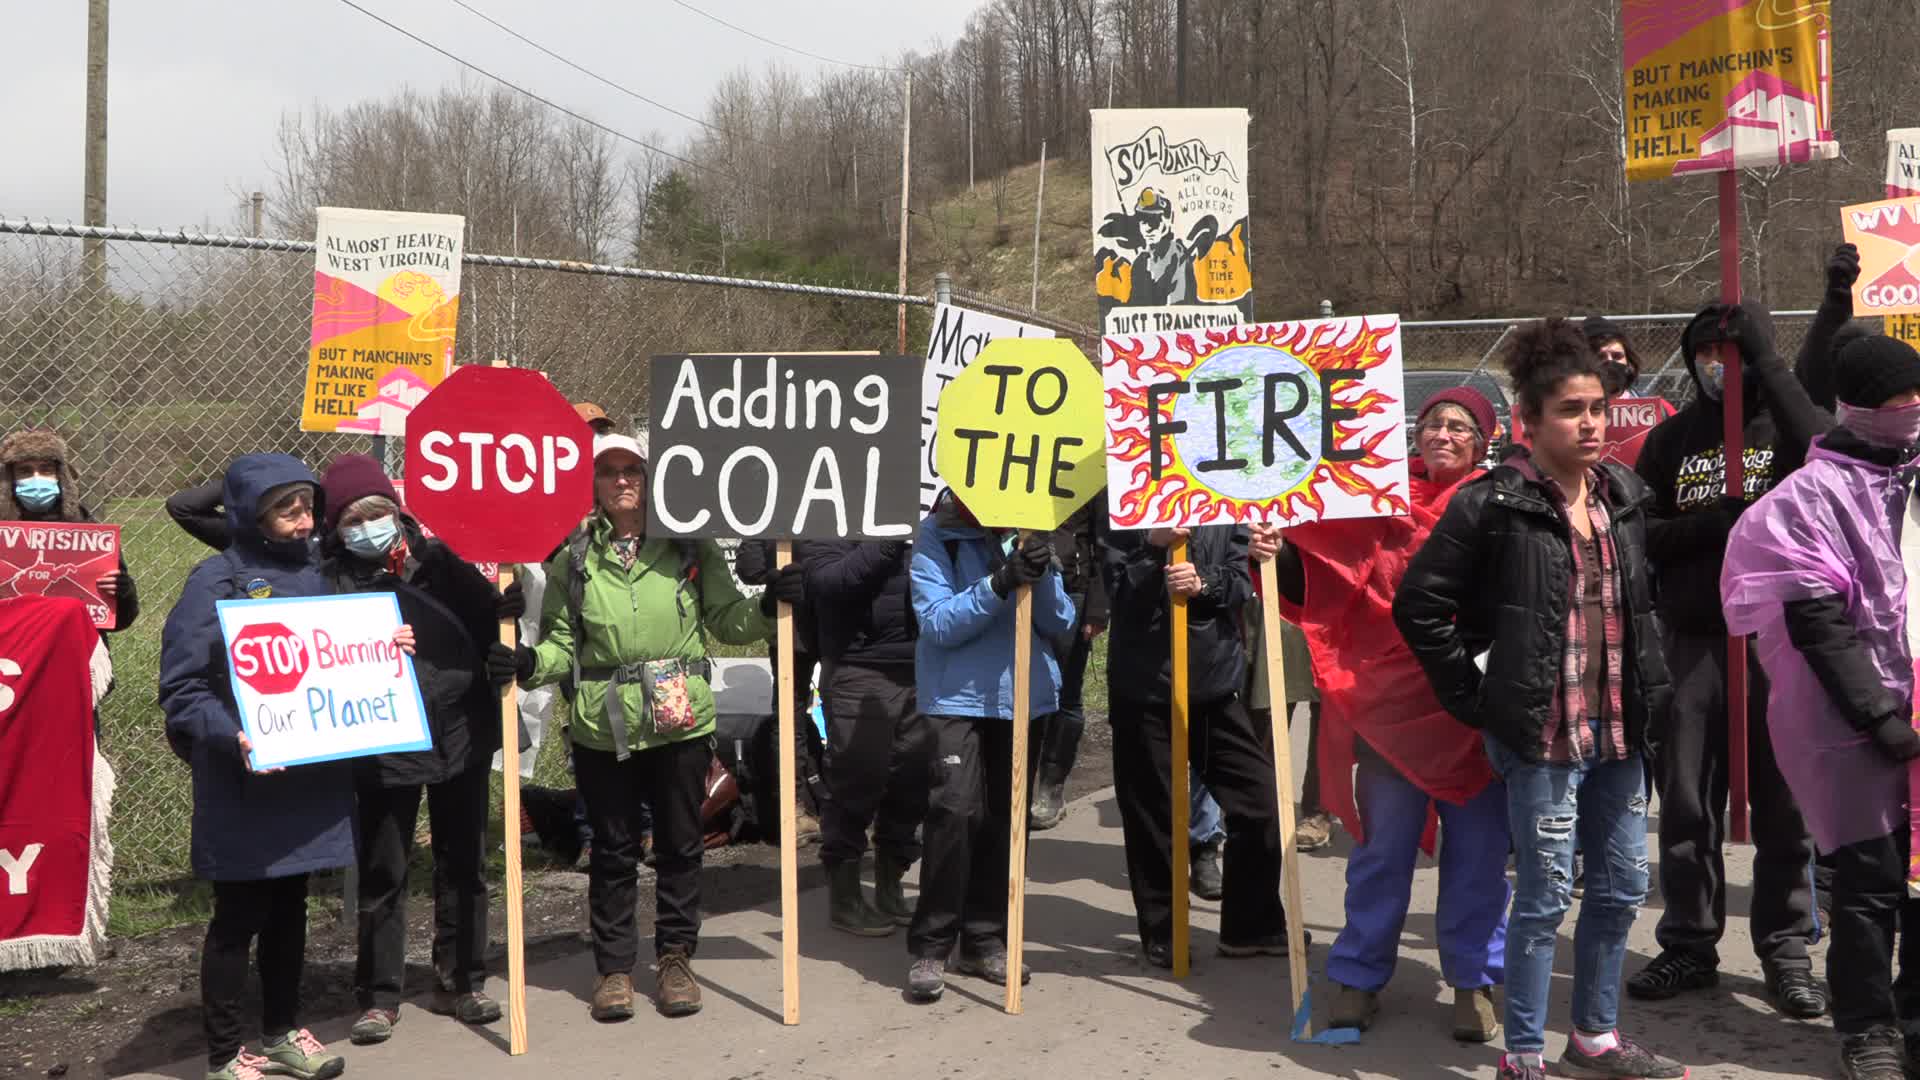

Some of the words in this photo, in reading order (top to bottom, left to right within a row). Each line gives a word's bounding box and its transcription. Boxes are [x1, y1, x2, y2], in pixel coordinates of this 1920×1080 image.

[1632, 65, 1671, 87] BUT
[1679, 47, 1793, 81] MANCHIN'S
[1632, 83, 1711, 110] MAKING
[1634, 115, 1651, 134] IT
[1660, 109, 1702, 131] LIKE
[1634, 133, 1695, 159] HELL
[1117, 134, 1221, 185] SOLIDARITY
[1178, 186, 1198, 201] ALL
[1205, 185, 1235, 201] COAL
[1180, 199, 1233, 214] WORKERS
[1850, 206, 1902, 231] WV
[326, 234, 390, 253] ALMOST
[396, 233, 457, 252] HEAVEN
[327, 253, 373, 272] WEST
[379, 252, 451, 271] VIRGINIA
[1208, 271, 1233, 281] TIME
[1111, 312, 1148, 335] JUST
[318, 347, 347, 362] BUT
[352, 348, 433, 366] MANCHIN'S
[316, 365, 375, 381] MAKING
[315, 382, 330, 396] IT
[334, 382, 367, 398] LIKE
[661, 357, 889, 434] Adding
[984, 364, 1068, 415] TO
[313, 399, 359, 417] HELL
[1149, 368, 1366, 481] FIRE
[420, 430, 580, 495] STOP
[954, 428, 1084, 499] THE
[653, 445, 913, 537] COAL
[1676, 483, 1721, 503] Love
[30, 529, 114, 552] RISING
[29, 570, 51, 581] FOR
[233, 634, 305, 677] STOP
[312, 628, 403, 679] Burning
[257, 703, 297, 736] Our
[306, 687, 398, 732] Planet
